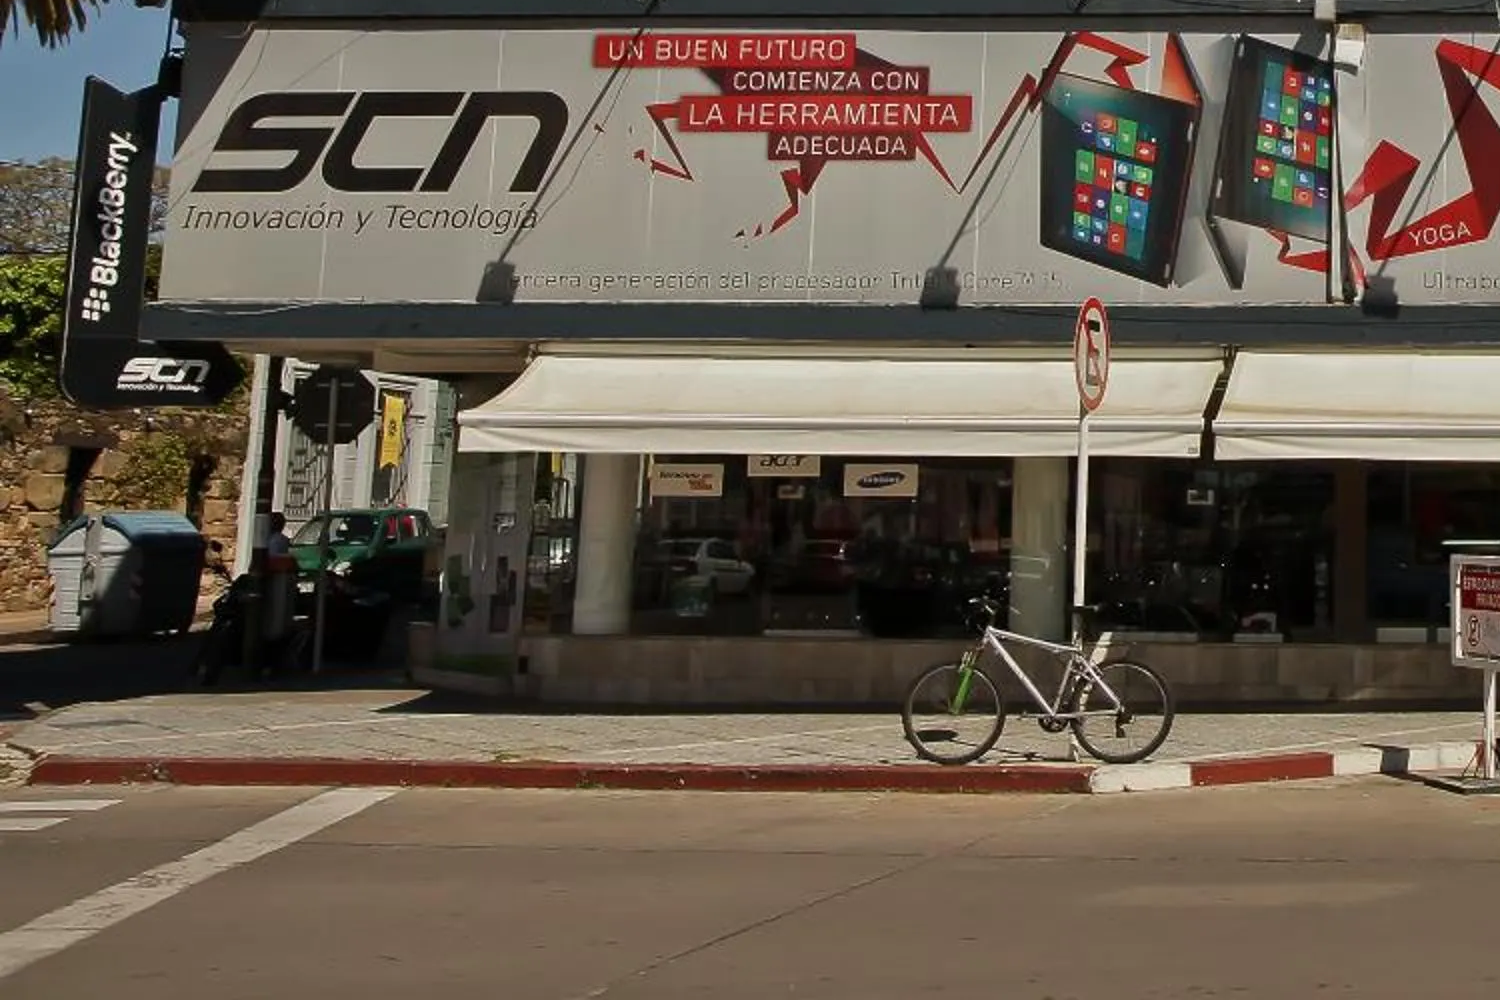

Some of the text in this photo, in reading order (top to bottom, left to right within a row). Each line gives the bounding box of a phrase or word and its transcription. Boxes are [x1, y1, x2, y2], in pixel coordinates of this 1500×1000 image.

[608, 38, 846, 61] UN BUEN FUTURO
[733, 70, 920, 91] COMIENZA CON
[689, 102, 960, 126] LA HERRAMIENTA
[775, 135, 908, 156] ADECUADA
[90, 130, 138, 287] BlackBerry
[181, 201, 539, 235] Innovación y Tecnología
[1408, 221, 1472, 247] YOGA
[588, 266, 710, 292] generación
[719, 271, 750, 289] del
